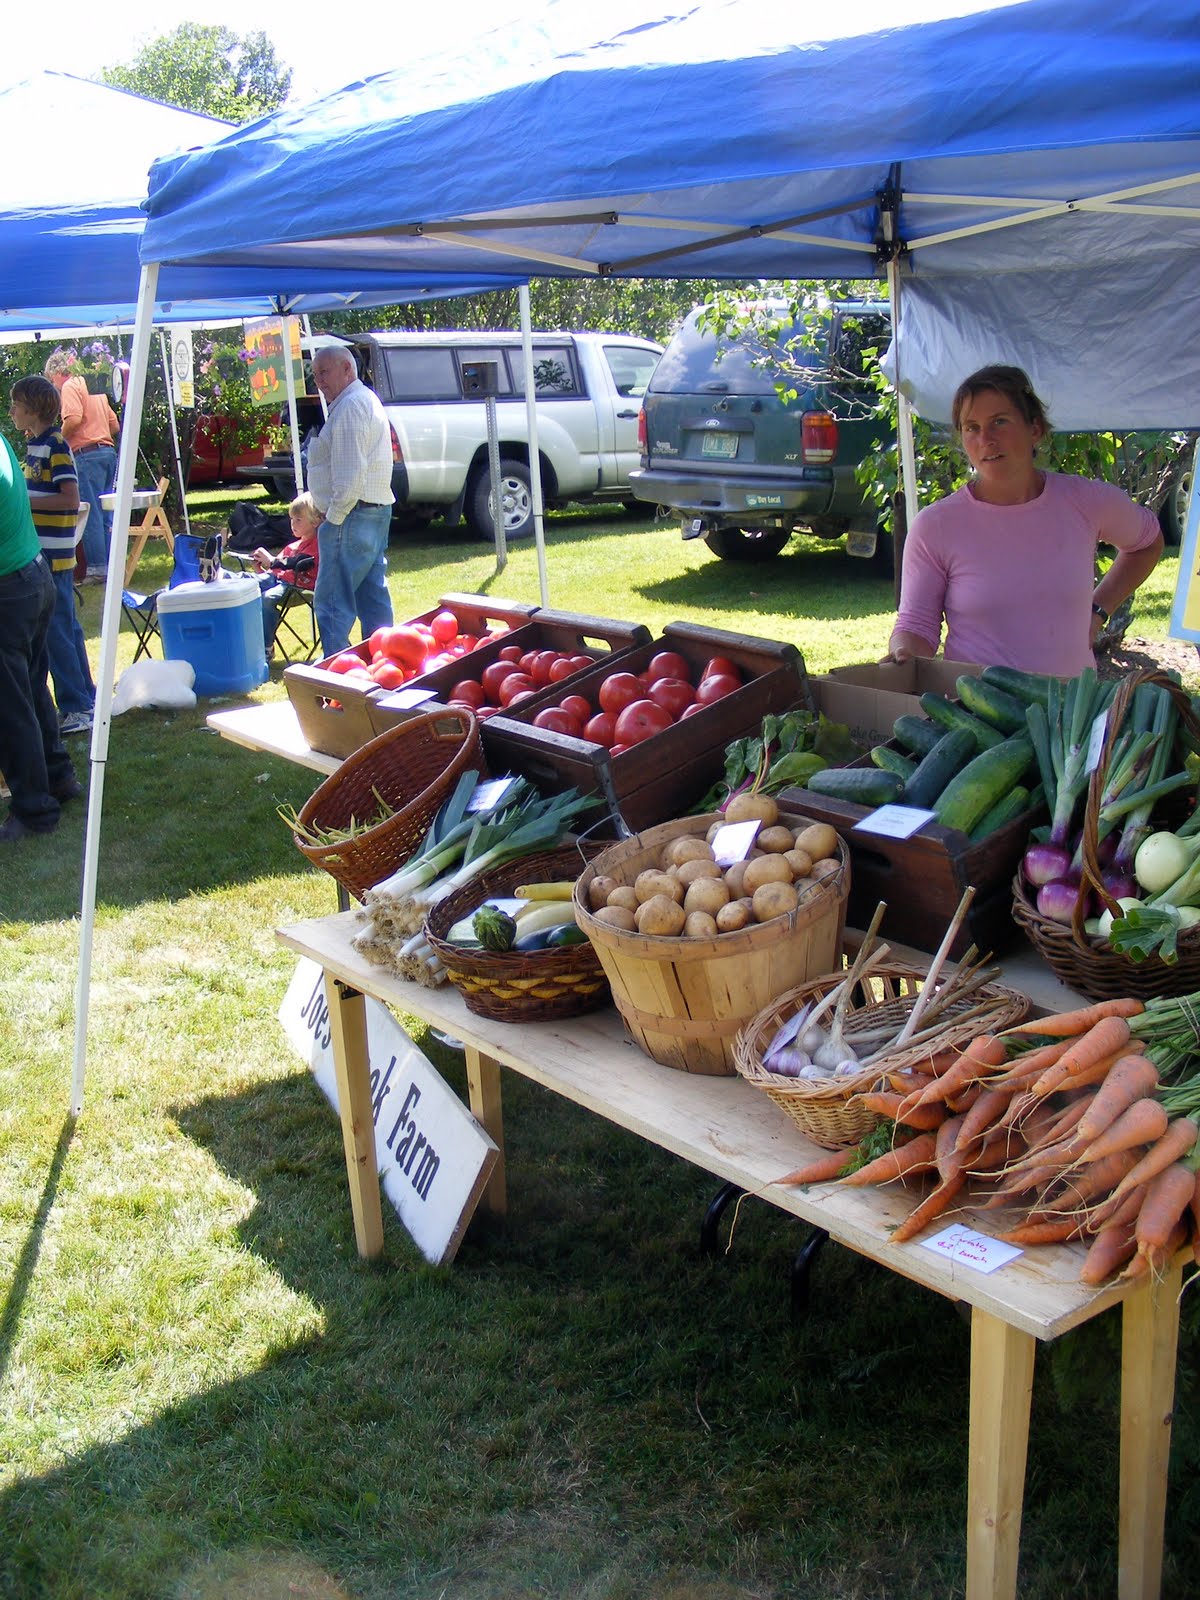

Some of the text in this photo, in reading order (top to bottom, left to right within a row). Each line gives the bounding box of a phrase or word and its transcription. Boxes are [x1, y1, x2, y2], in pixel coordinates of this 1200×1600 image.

[757, 495, 767, 504] Buy
[386, 1082, 441, 1202] Farm
[959, 1250, 987, 1262] bunch
